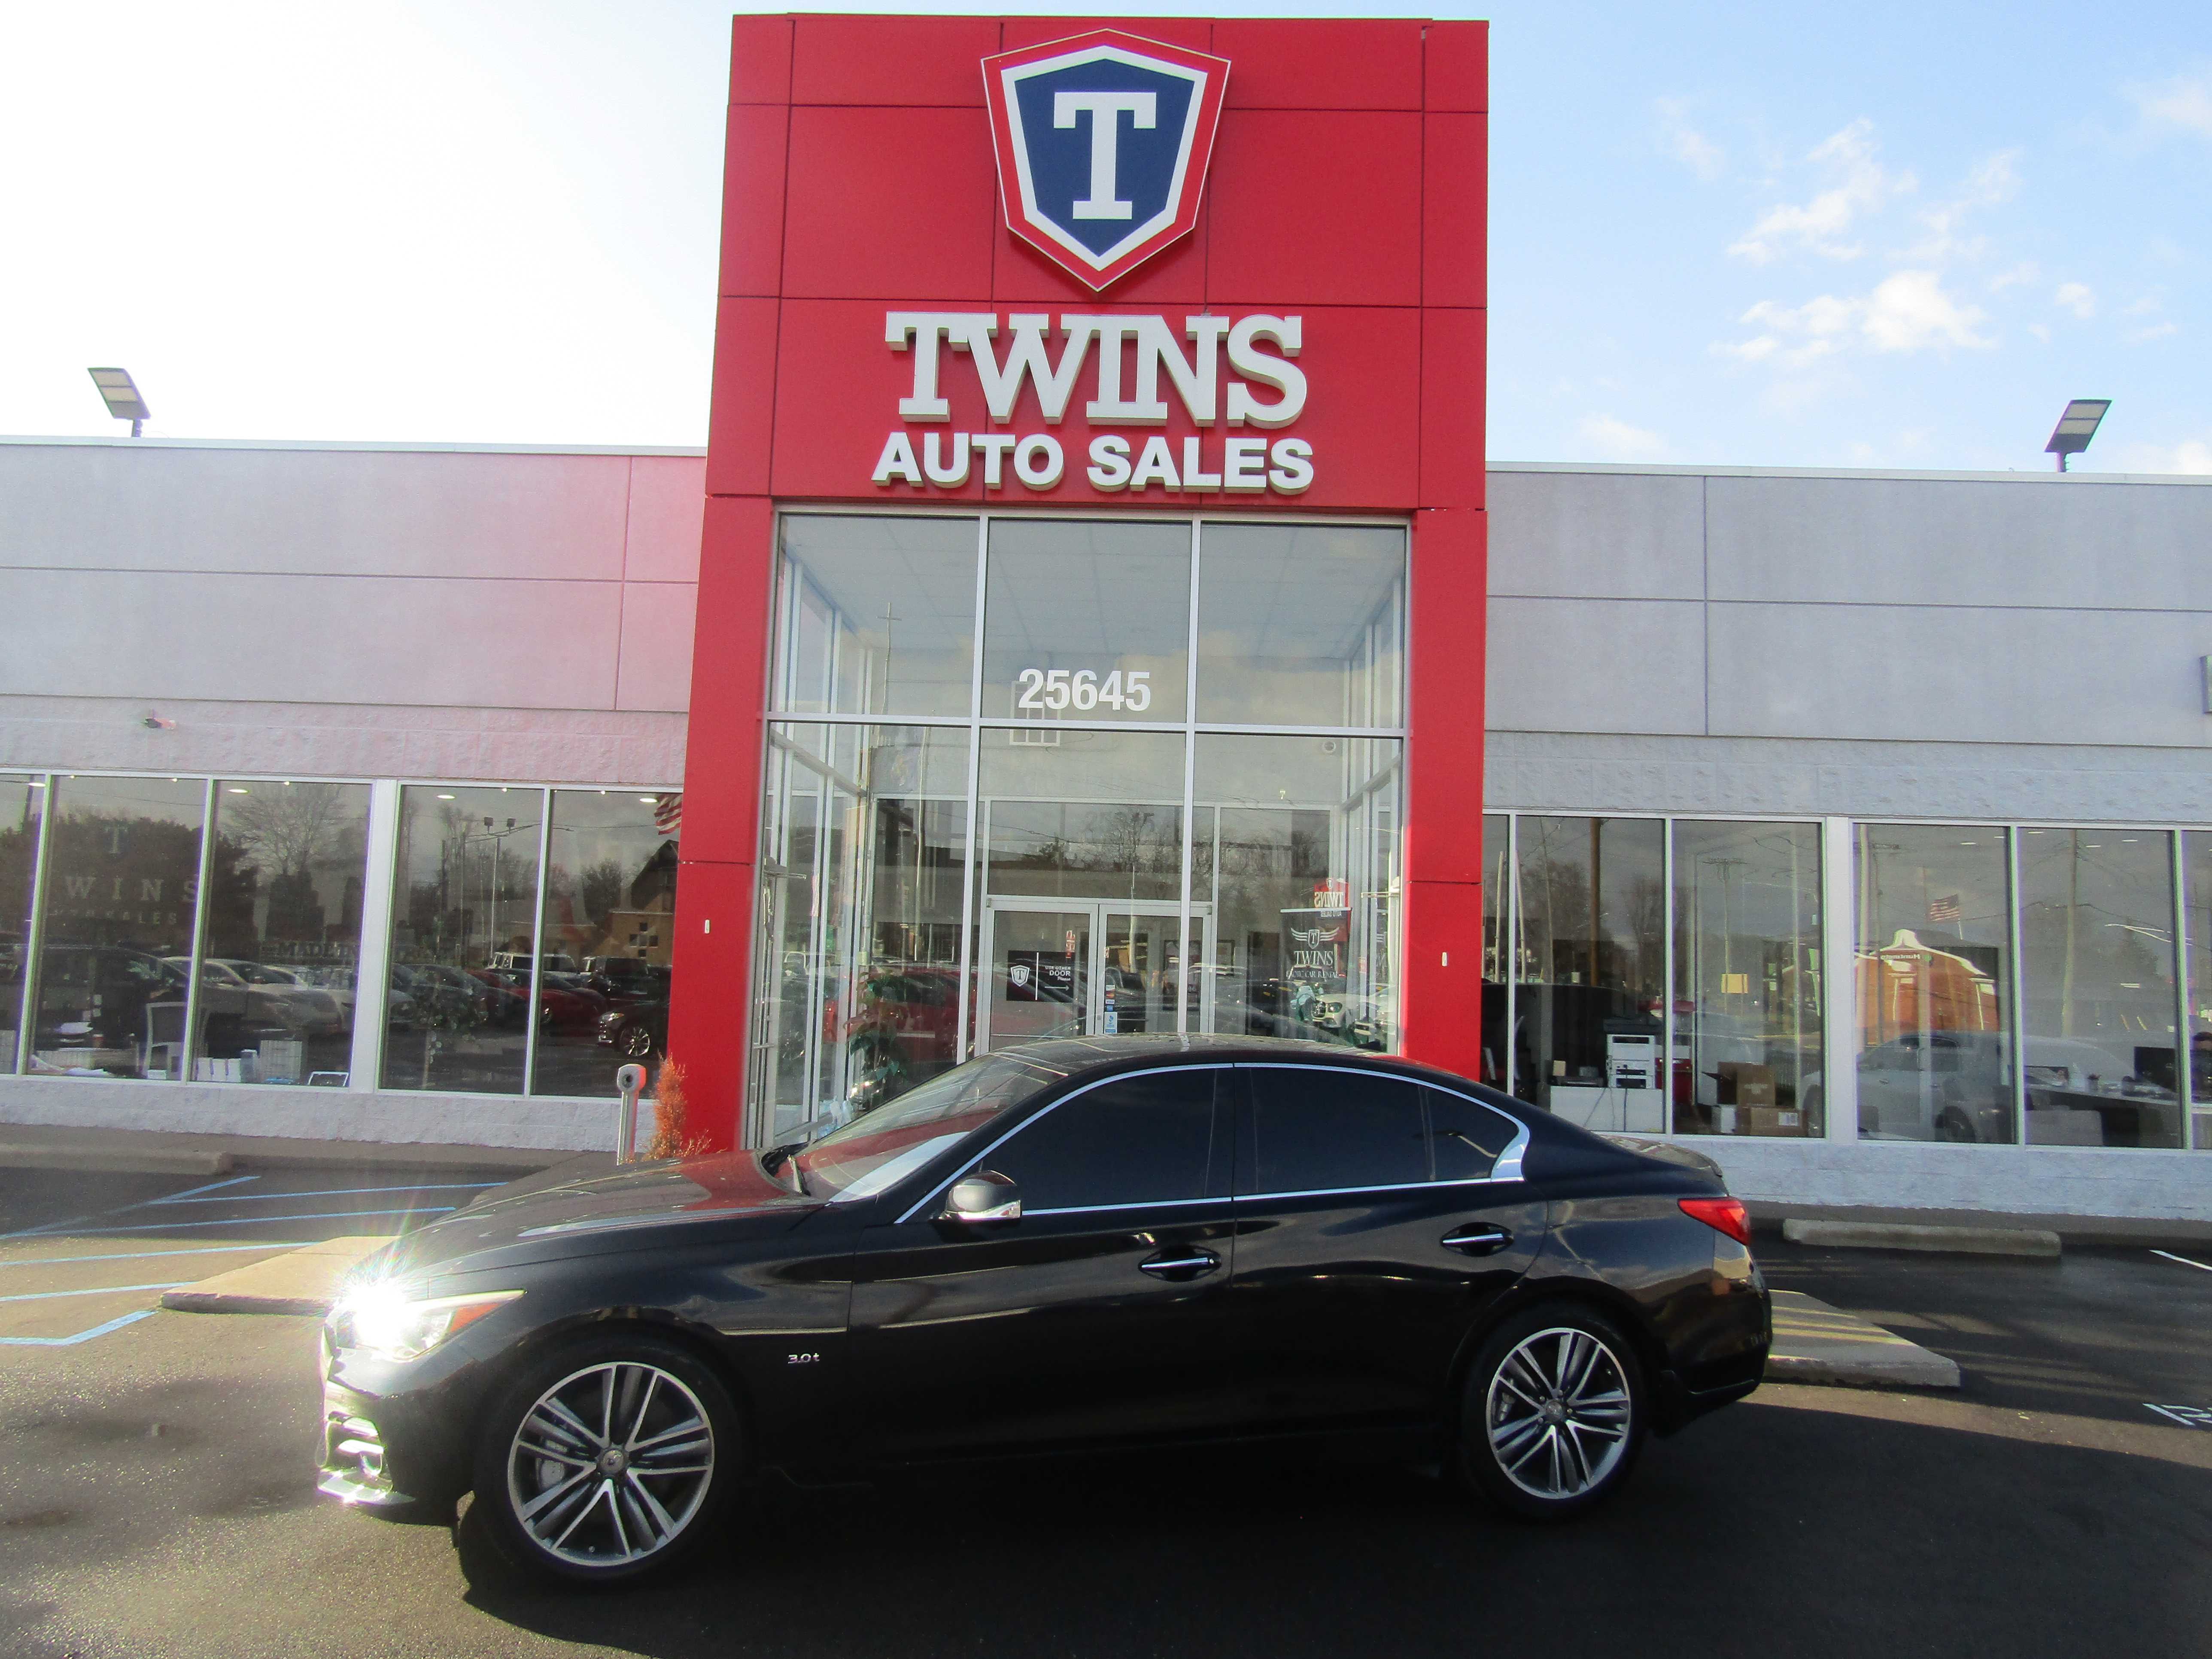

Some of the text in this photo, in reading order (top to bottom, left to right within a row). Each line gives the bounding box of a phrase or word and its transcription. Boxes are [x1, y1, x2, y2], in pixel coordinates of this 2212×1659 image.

[1054, 91, 1157, 220] T
[885, 311, 1307, 429] TWINS
[871, 431, 1315, 495] AUTO SALES
[1018, 668, 1151, 711] 25645
[1015, 969, 1024, 980] T
[1294, 950, 1334, 966] TWINS
[787, 1352, 820, 1364] 3.0t
